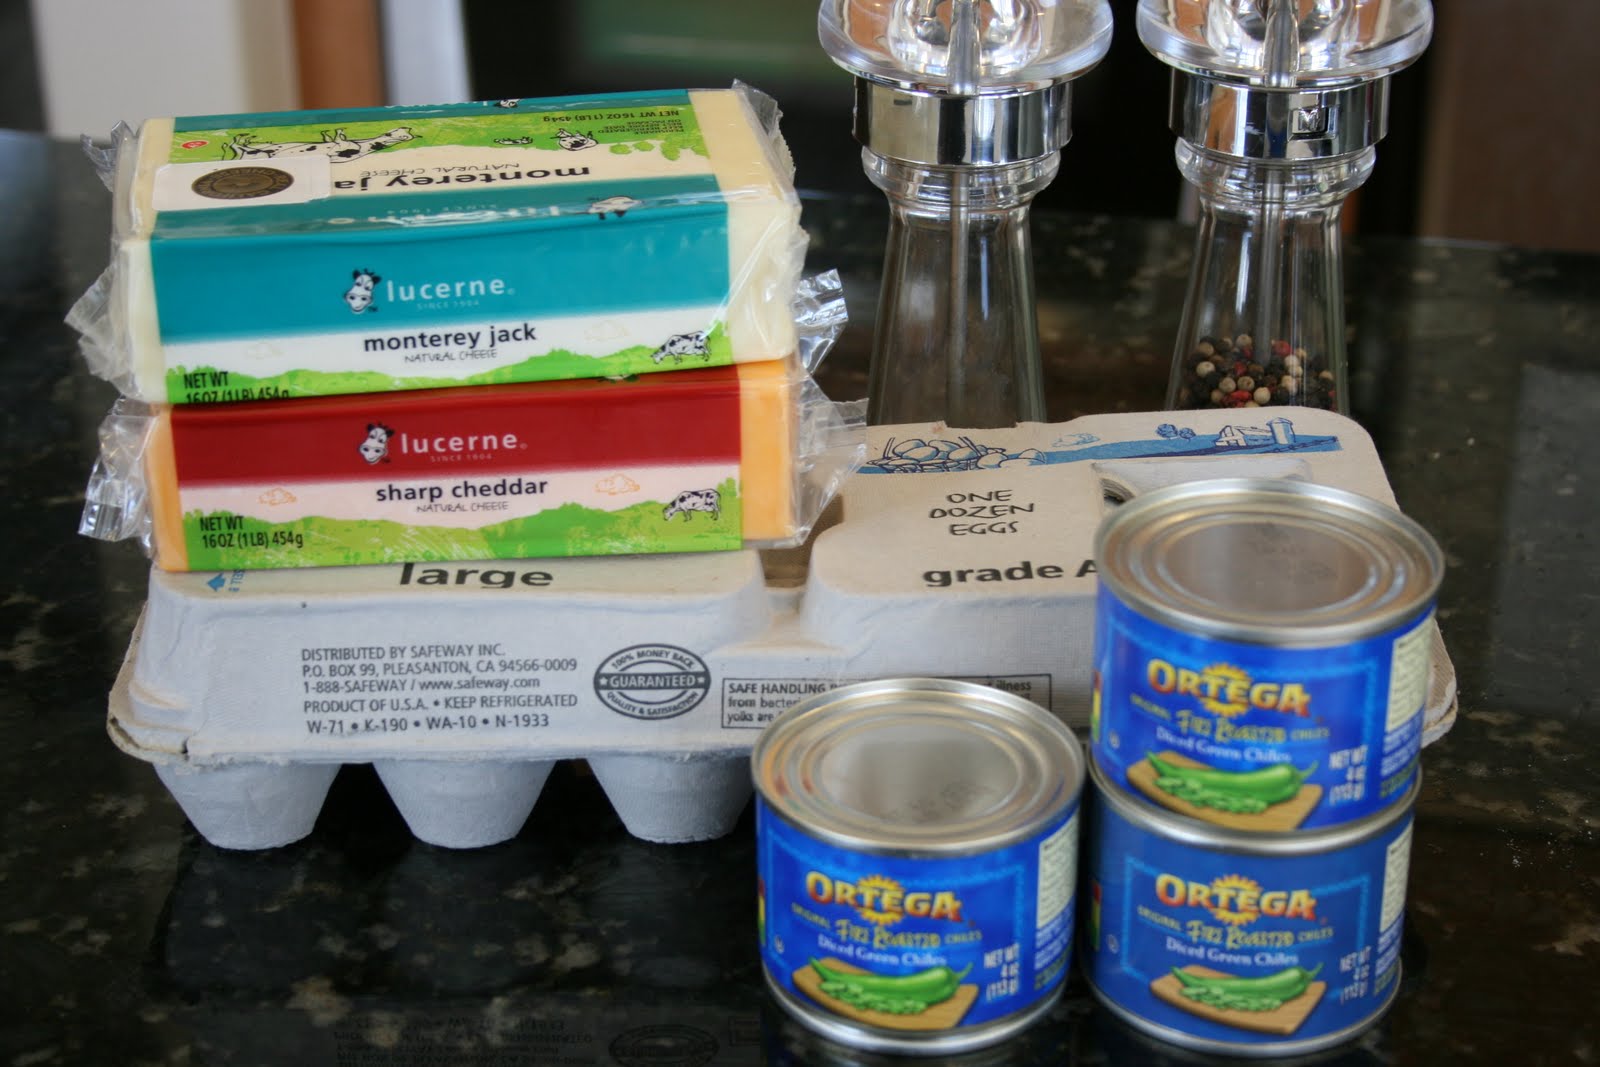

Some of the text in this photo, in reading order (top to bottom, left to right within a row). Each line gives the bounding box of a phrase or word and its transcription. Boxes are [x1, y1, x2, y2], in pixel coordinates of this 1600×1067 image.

[334, 166, 590, 191] monterey ja
[359, 163, 519, 177] NATURAL CHEESE
[387, 278, 506, 302] lucerne
[364, 323, 536, 352] monterey jack
[405, 349, 497, 363] NATURAL CHEESE
[183, 371, 229, 389] NET WT
[401, 433, 518, 454] lucerne
[376, 478, 548, 503] sharp cheddar
[946, 489, 1013, 504] ONE
[416, 501, 509, 513] NATURAL CHEESE
[929, 502, 1035, 519] DOZEN
[200, 516, 244, 532] NET WT
[949, 521, 1019, 536] EGGS
[272, 531, 304, 549] 454g
[400, 562, 554, 589] large
[922, 560, 1098, 588] grade A
[301, 643, 506, 662] DISTRIBUTED BY SAFEWAY INC.
[611, 649, 695, 669] 100% MONEY BACK
[302, 658, 578, 678] P.O. BOX 99, PLEASANTON, CA 94566-0009
[303, 678, 409, 694] 1-888-SAFEWAY
[418, 675, 541, 692] www.safeway.com
[610, 675, 696, 688] GUARANTEED
[728, 683, 758, 694] SAFE
[761, 683, 826, 694] HANDLING
[1147, 658, 1311, 717] ORTEGA
[303, 694, 578, 714] PRODUCT OF U.S.A. KEEP REFRIGERATED
[607, 691, 637, 713] QUALITY
[647, 691, 699, 716] SATISFACTION
[728, 697, 756, 707] from
[306, 713, 550, 734] W-71 K-190 WA-10 N-1933
[728, 711, 754, 724] yolks
[757, 713, 774, 721] are
[805, 870, 963, 923] ORTEGA
[1155, 873, 1318, 921] ORTEGA
